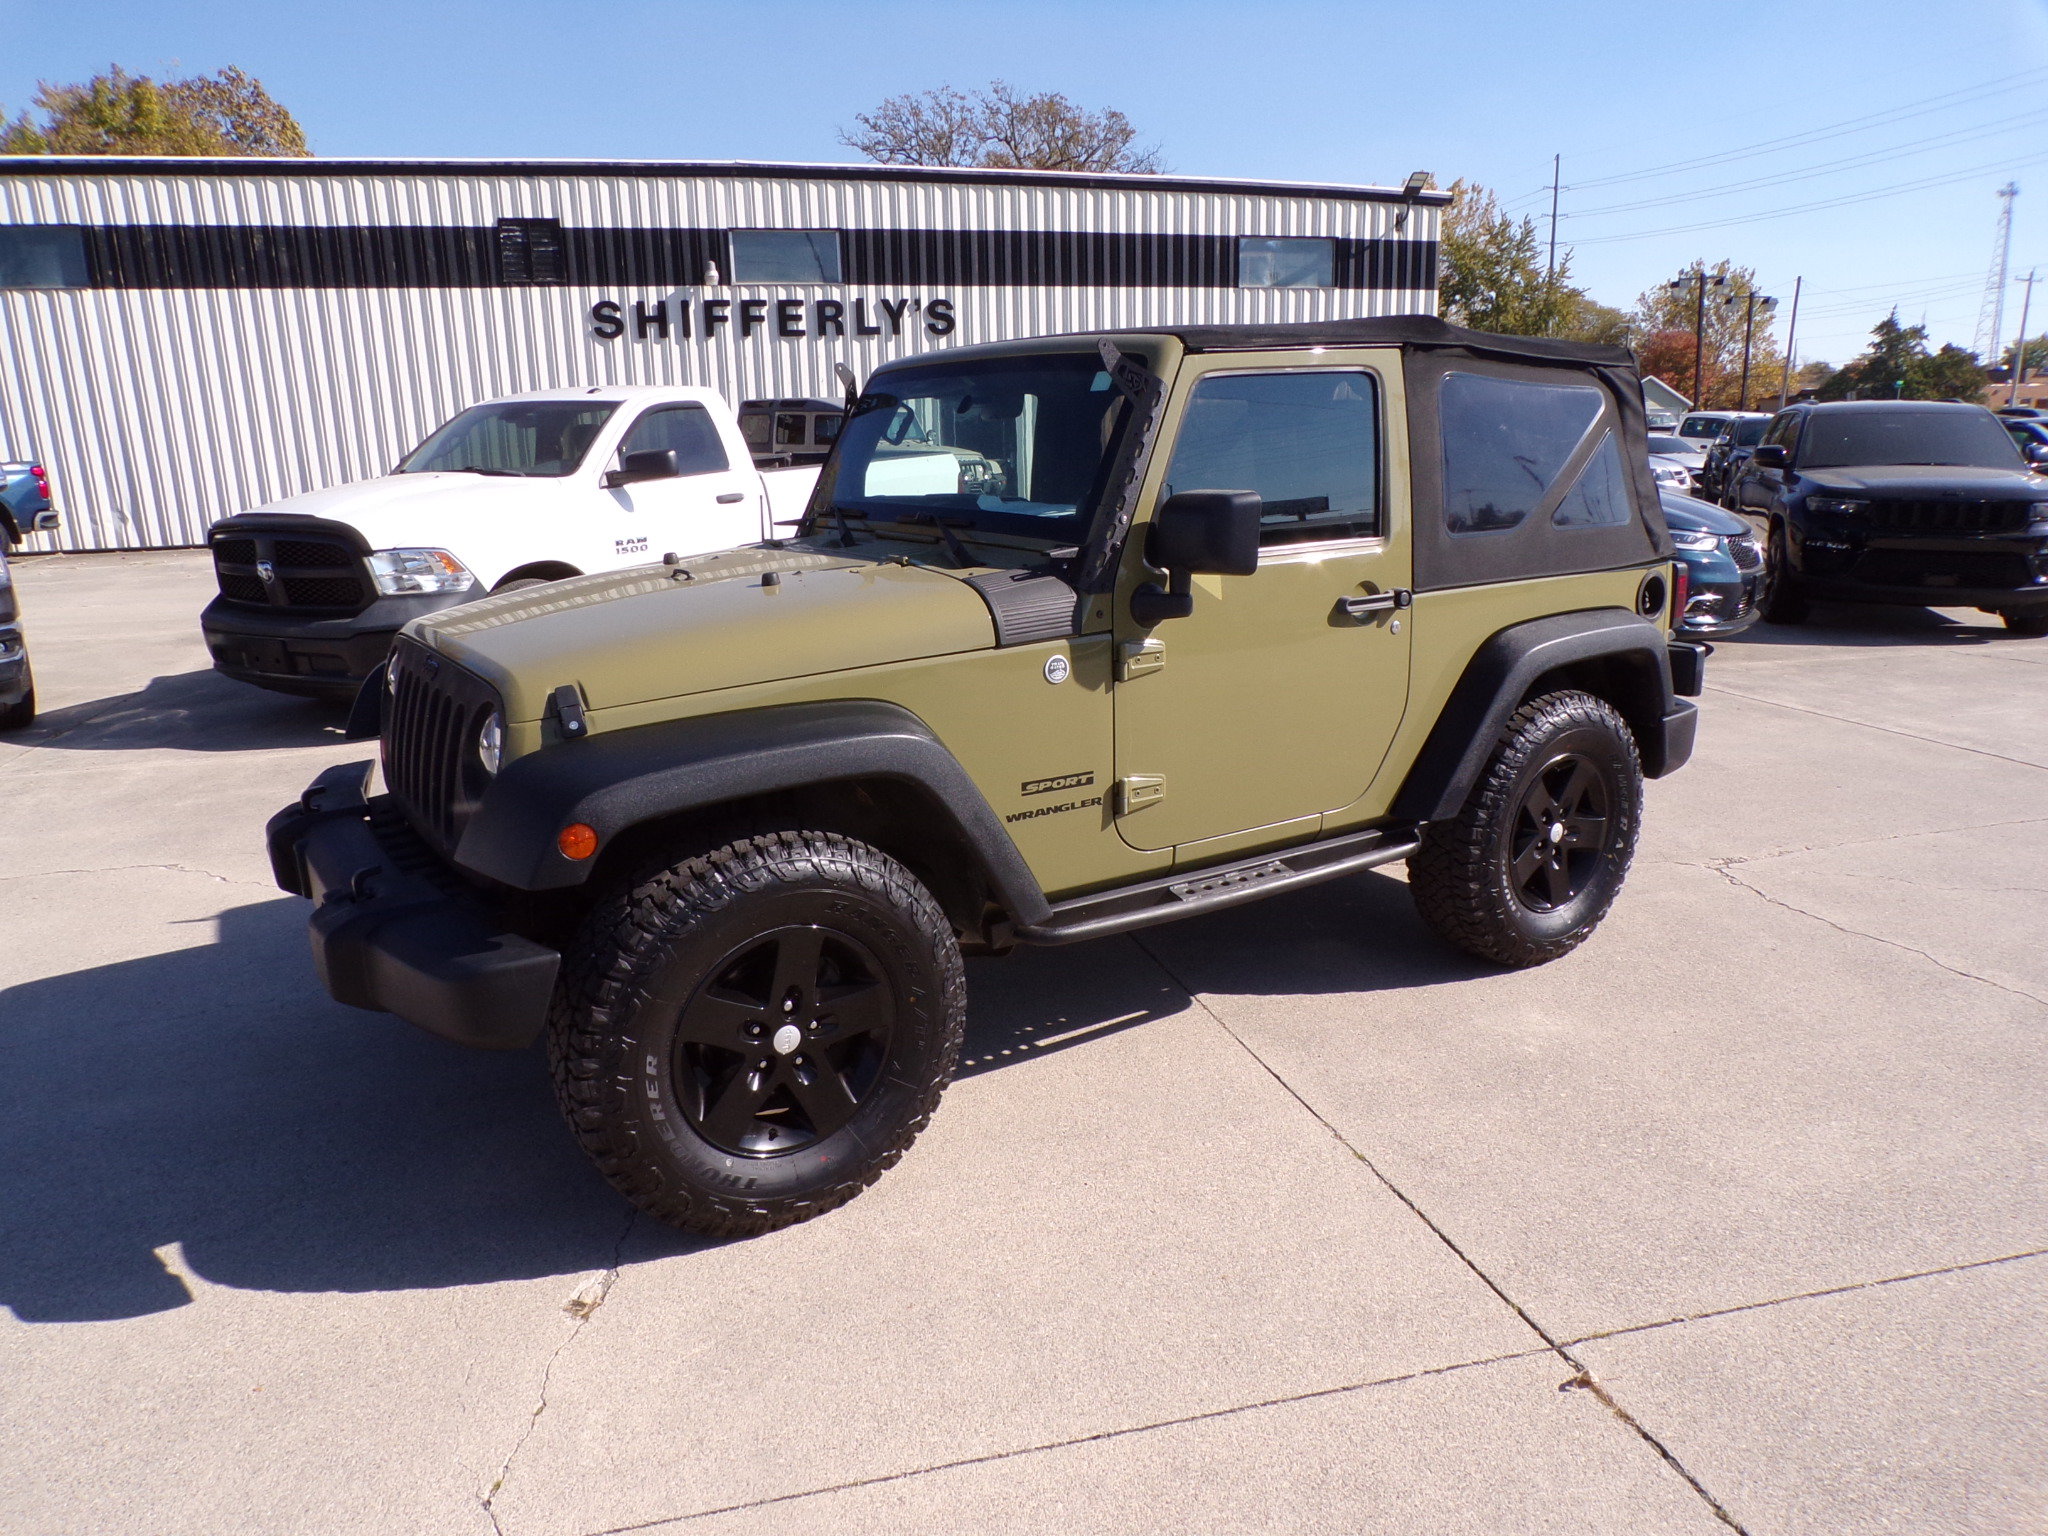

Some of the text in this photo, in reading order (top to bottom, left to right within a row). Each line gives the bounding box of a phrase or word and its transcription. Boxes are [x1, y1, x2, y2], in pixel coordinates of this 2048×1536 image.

[592, 297, 956, 340] SHIFFERLY'S
[615, 536, 648, 547] RAM
[616, 544, 648, 555] 1500
[1022, 772, 1094, 795] SPORT
[1006, 796, 1103, 823] WRANGLER
